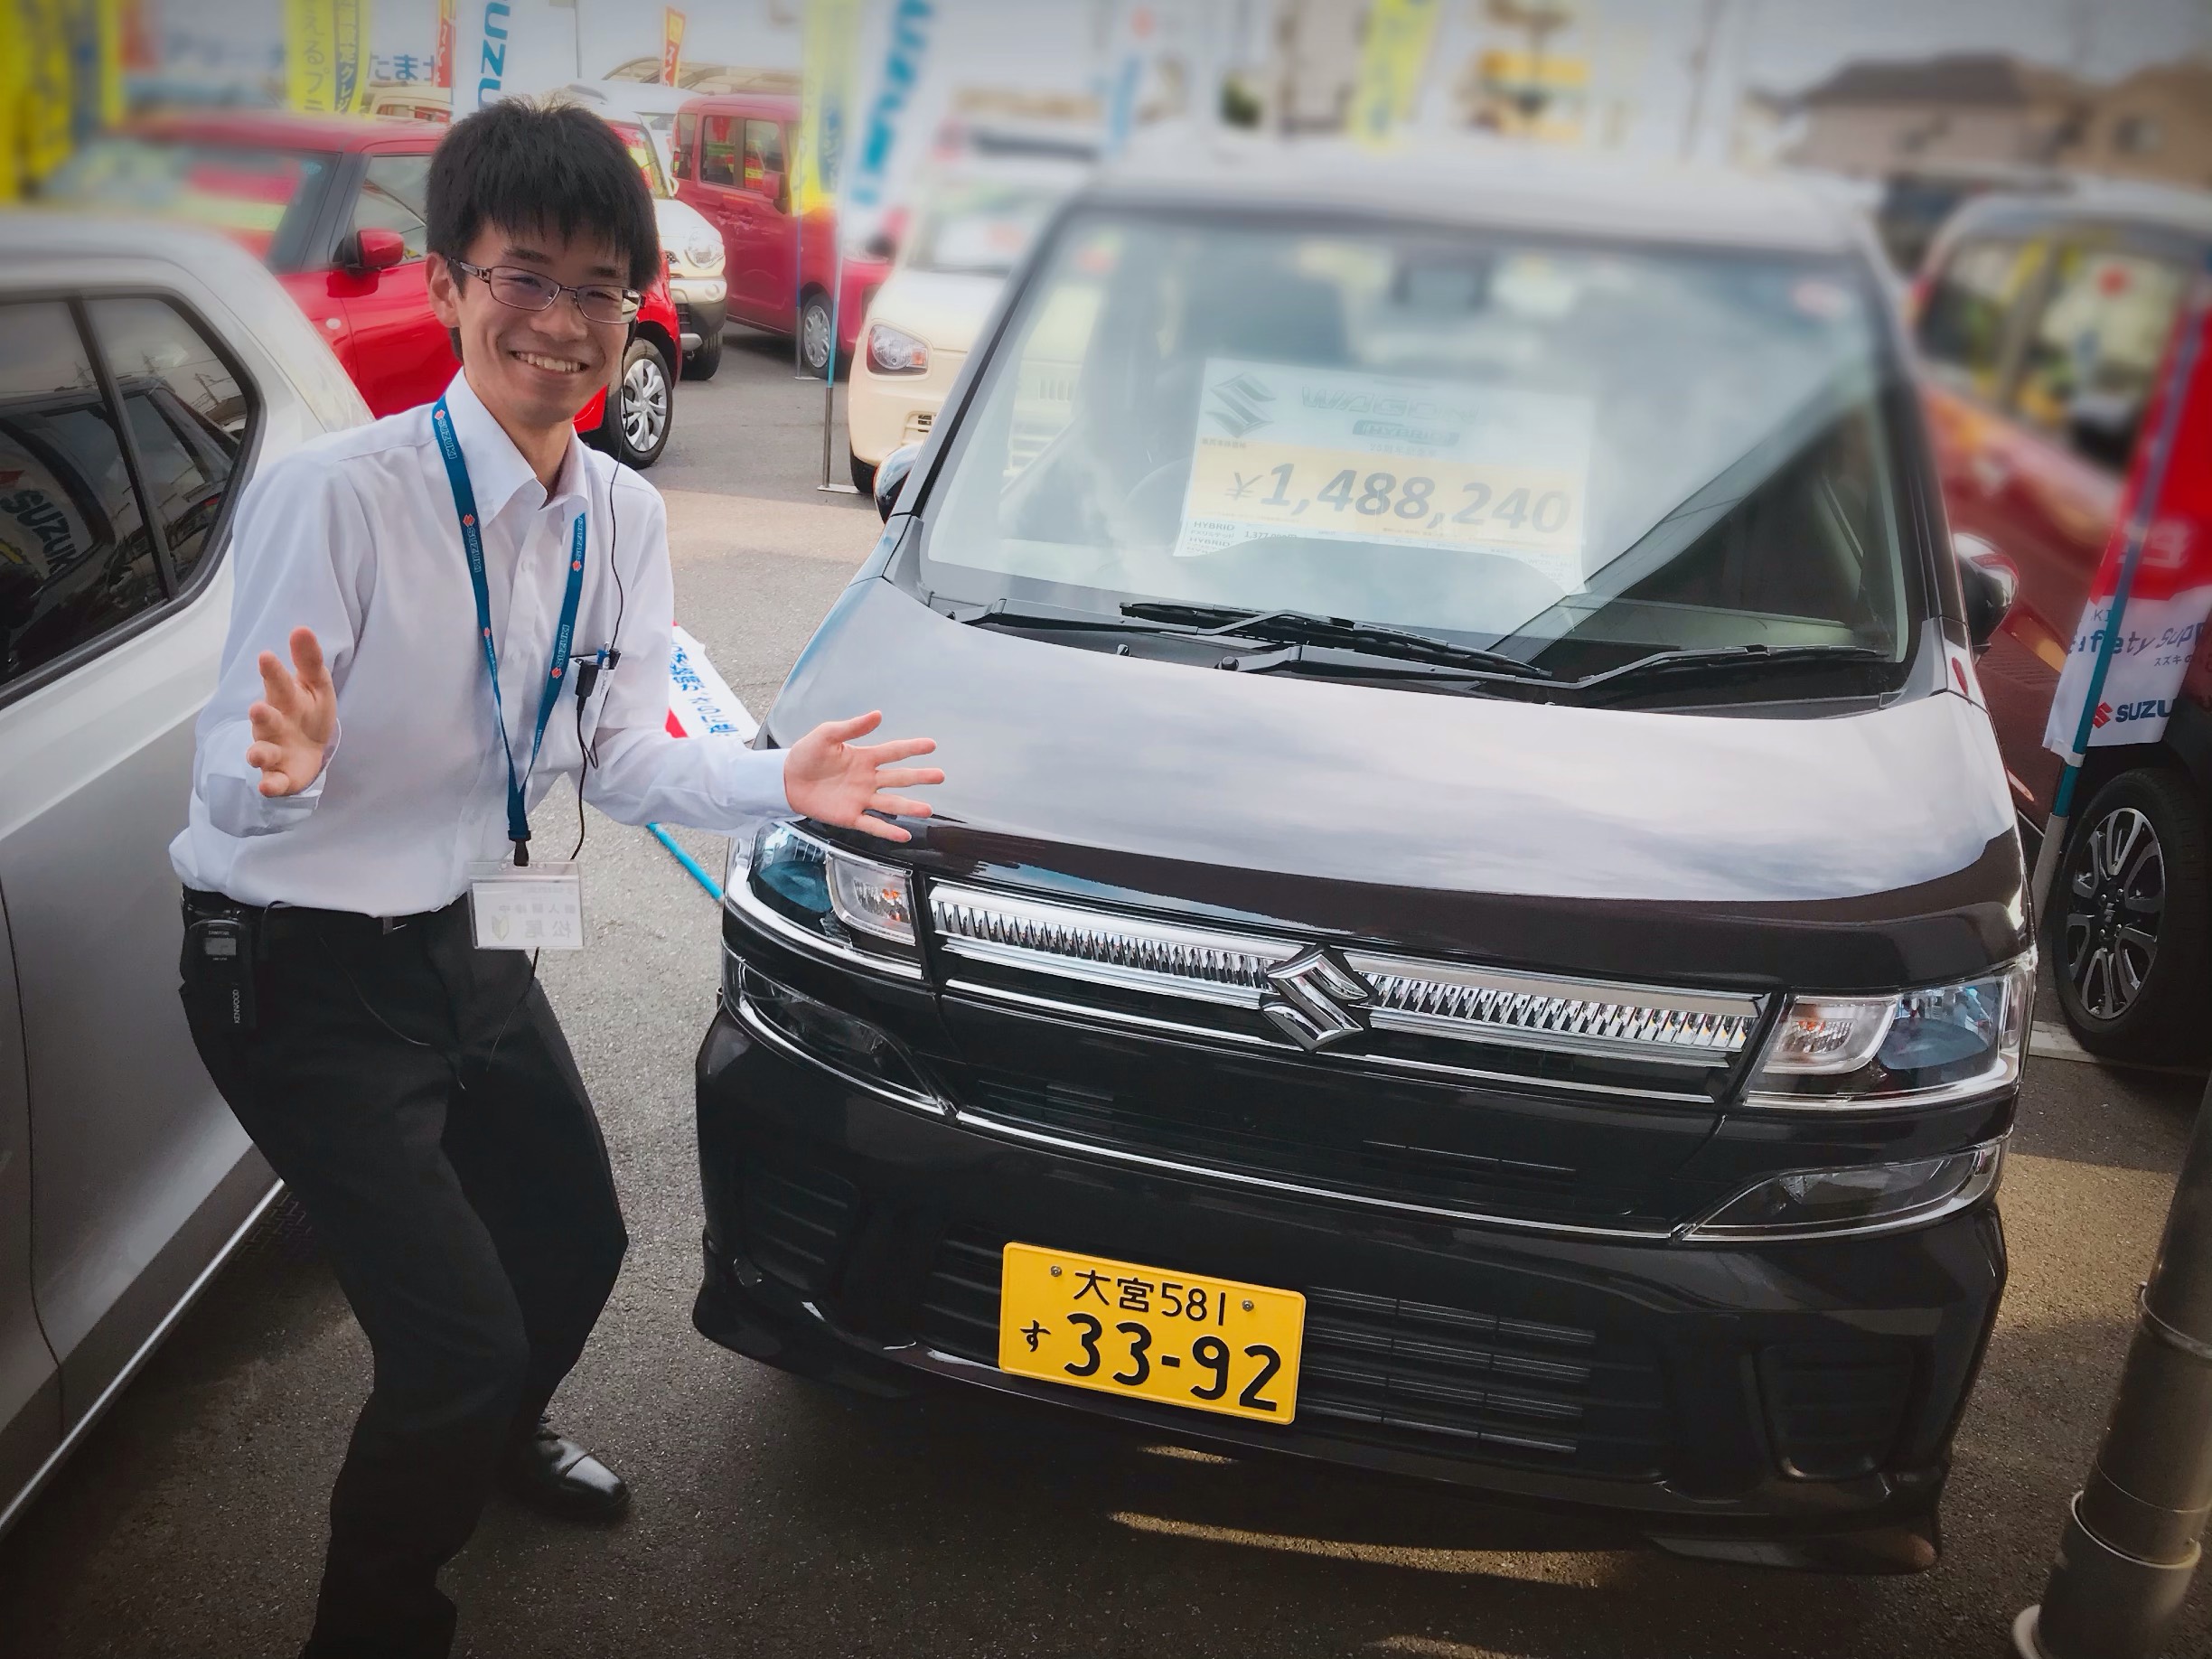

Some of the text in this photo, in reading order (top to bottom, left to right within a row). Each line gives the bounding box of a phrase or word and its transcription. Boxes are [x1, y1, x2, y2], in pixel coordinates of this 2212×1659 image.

[438, 417, 457, 460] SUZUKI
[1224, 462, 1571, 533] ¥1,488,240
[1194, 520, 1235, 531] HYBRID
[466, 526, 483, 573] SUZUKI
[556, 624, 570, 668] SUZUKI
[1019, 1312, 1281, 1412] す 33-92
